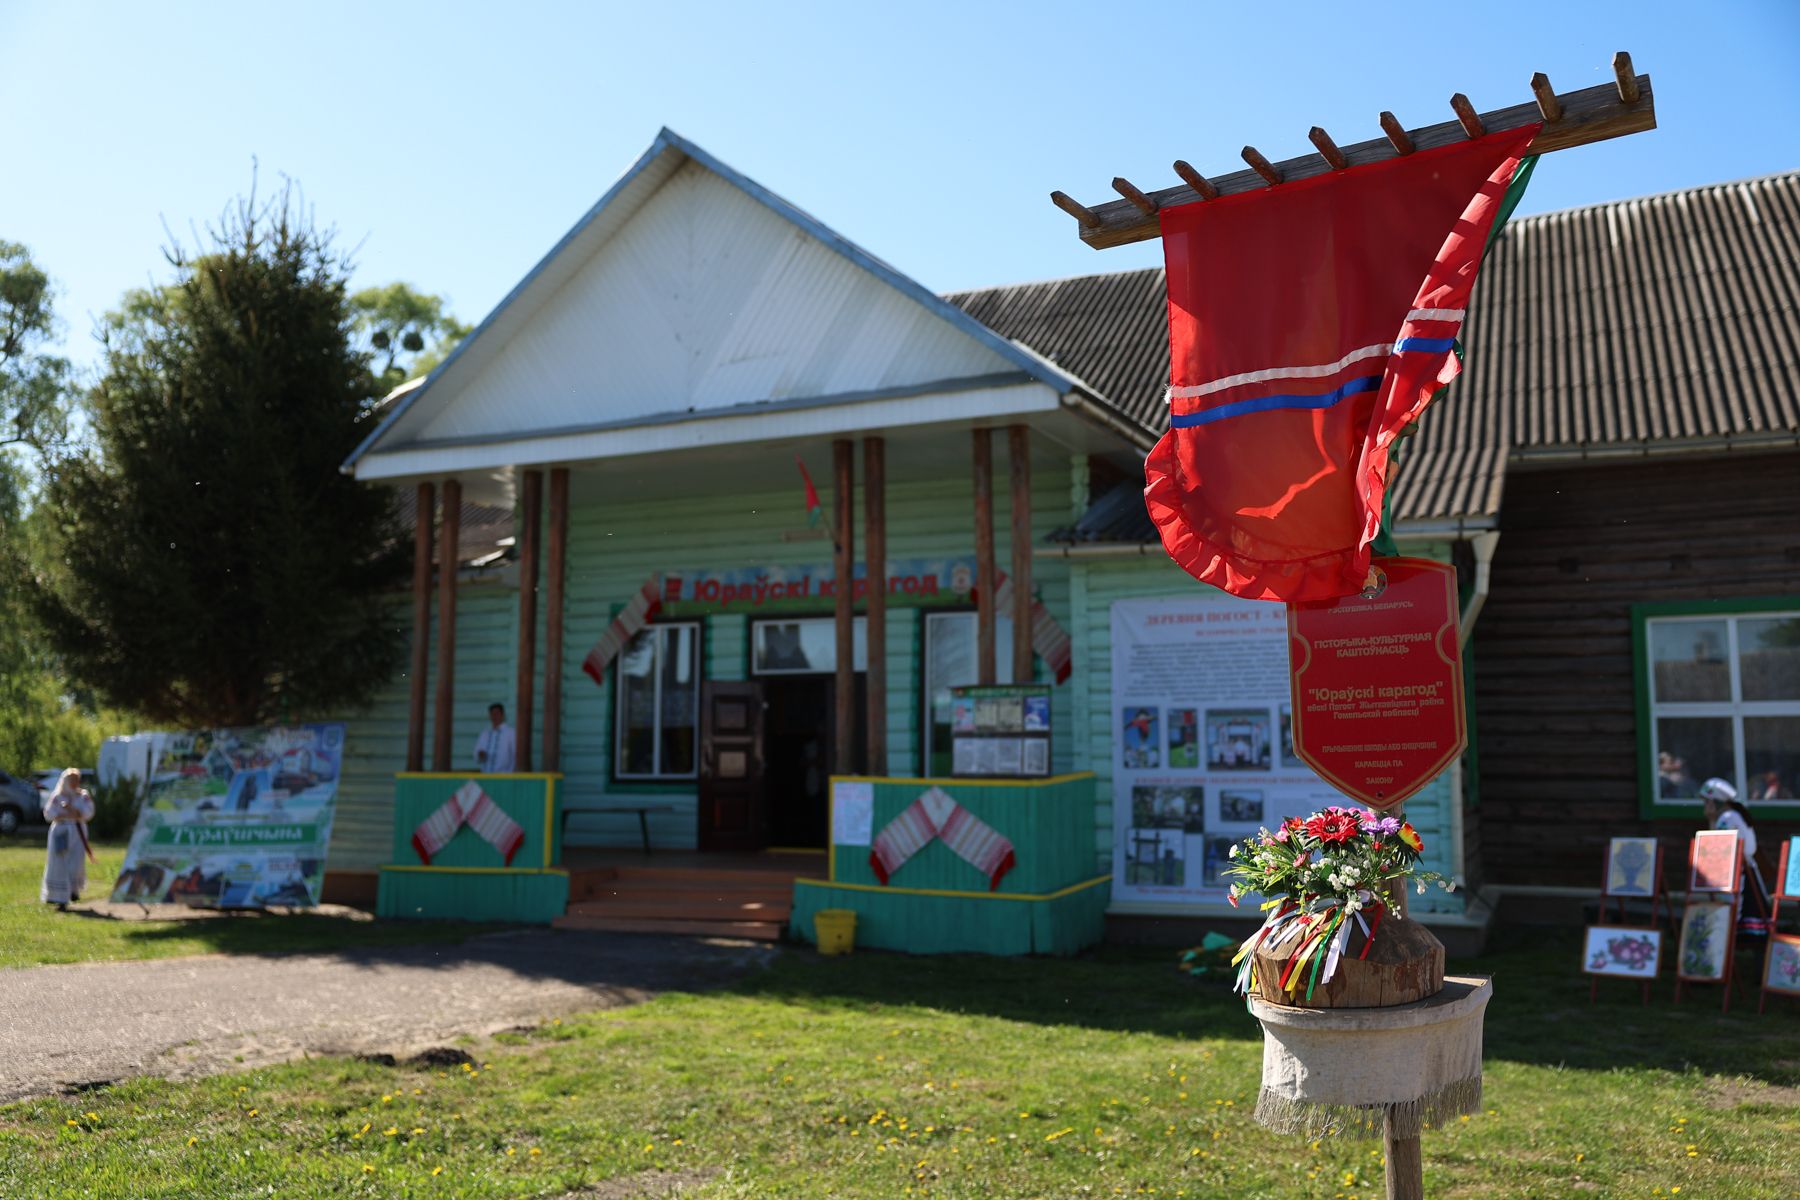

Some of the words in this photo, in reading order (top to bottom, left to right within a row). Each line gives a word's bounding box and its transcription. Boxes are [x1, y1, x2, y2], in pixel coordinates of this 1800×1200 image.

[693, 576, 809, 607] Юраўскі
[819, 573, 938, 605] кргод
[1373, 600, 1414, 611] БЕЛАРУСЬ
[1314, 632, 1432, 649] ГІСТОРЫКА-КУЛЬТУРНАЯ
[1336, 644, 1410, 658] КАШТОЎНАСЦЬ
[1308, 685, 1374, 701] "Юраўскі
[1378, 681, 1444, 700] карагод"
[1365, 777, 1394, 785] ЗАКОНУ
